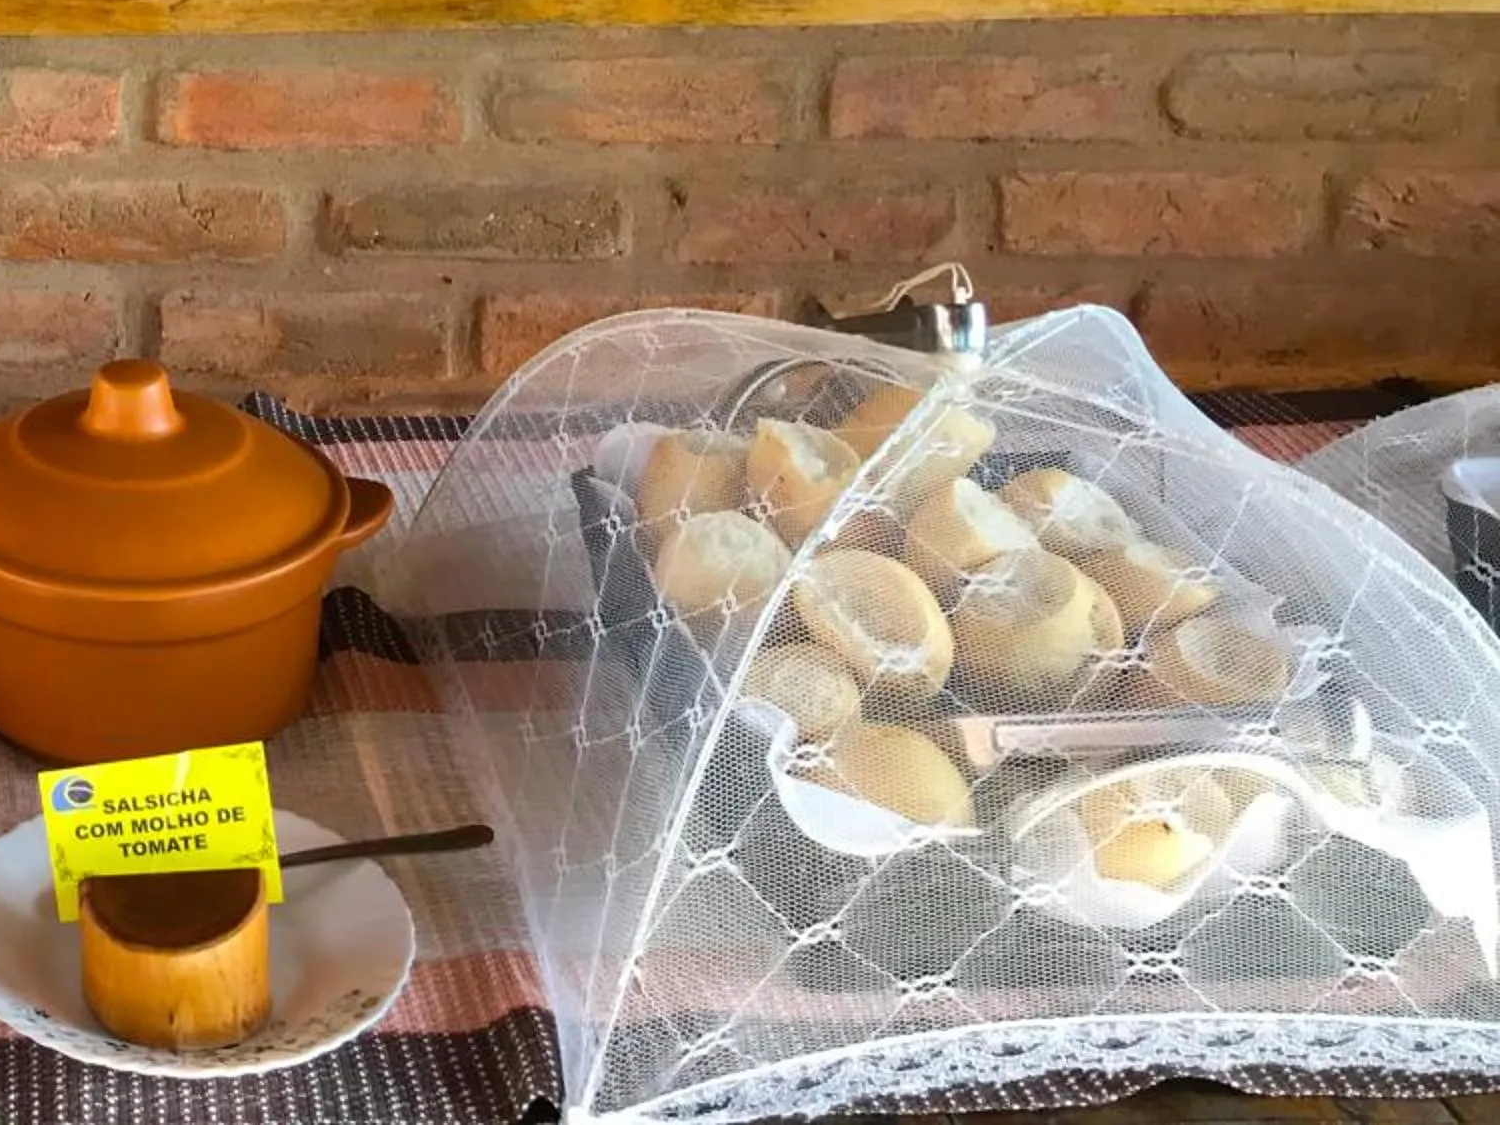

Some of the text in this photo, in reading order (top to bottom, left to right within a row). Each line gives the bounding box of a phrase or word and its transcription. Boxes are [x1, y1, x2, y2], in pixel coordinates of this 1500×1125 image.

[102, 787, 213, 816] SALSICHA
[75, 806, 246, 841] COM MOLHO DE
[118, 832, 208, 858] TOMATE
